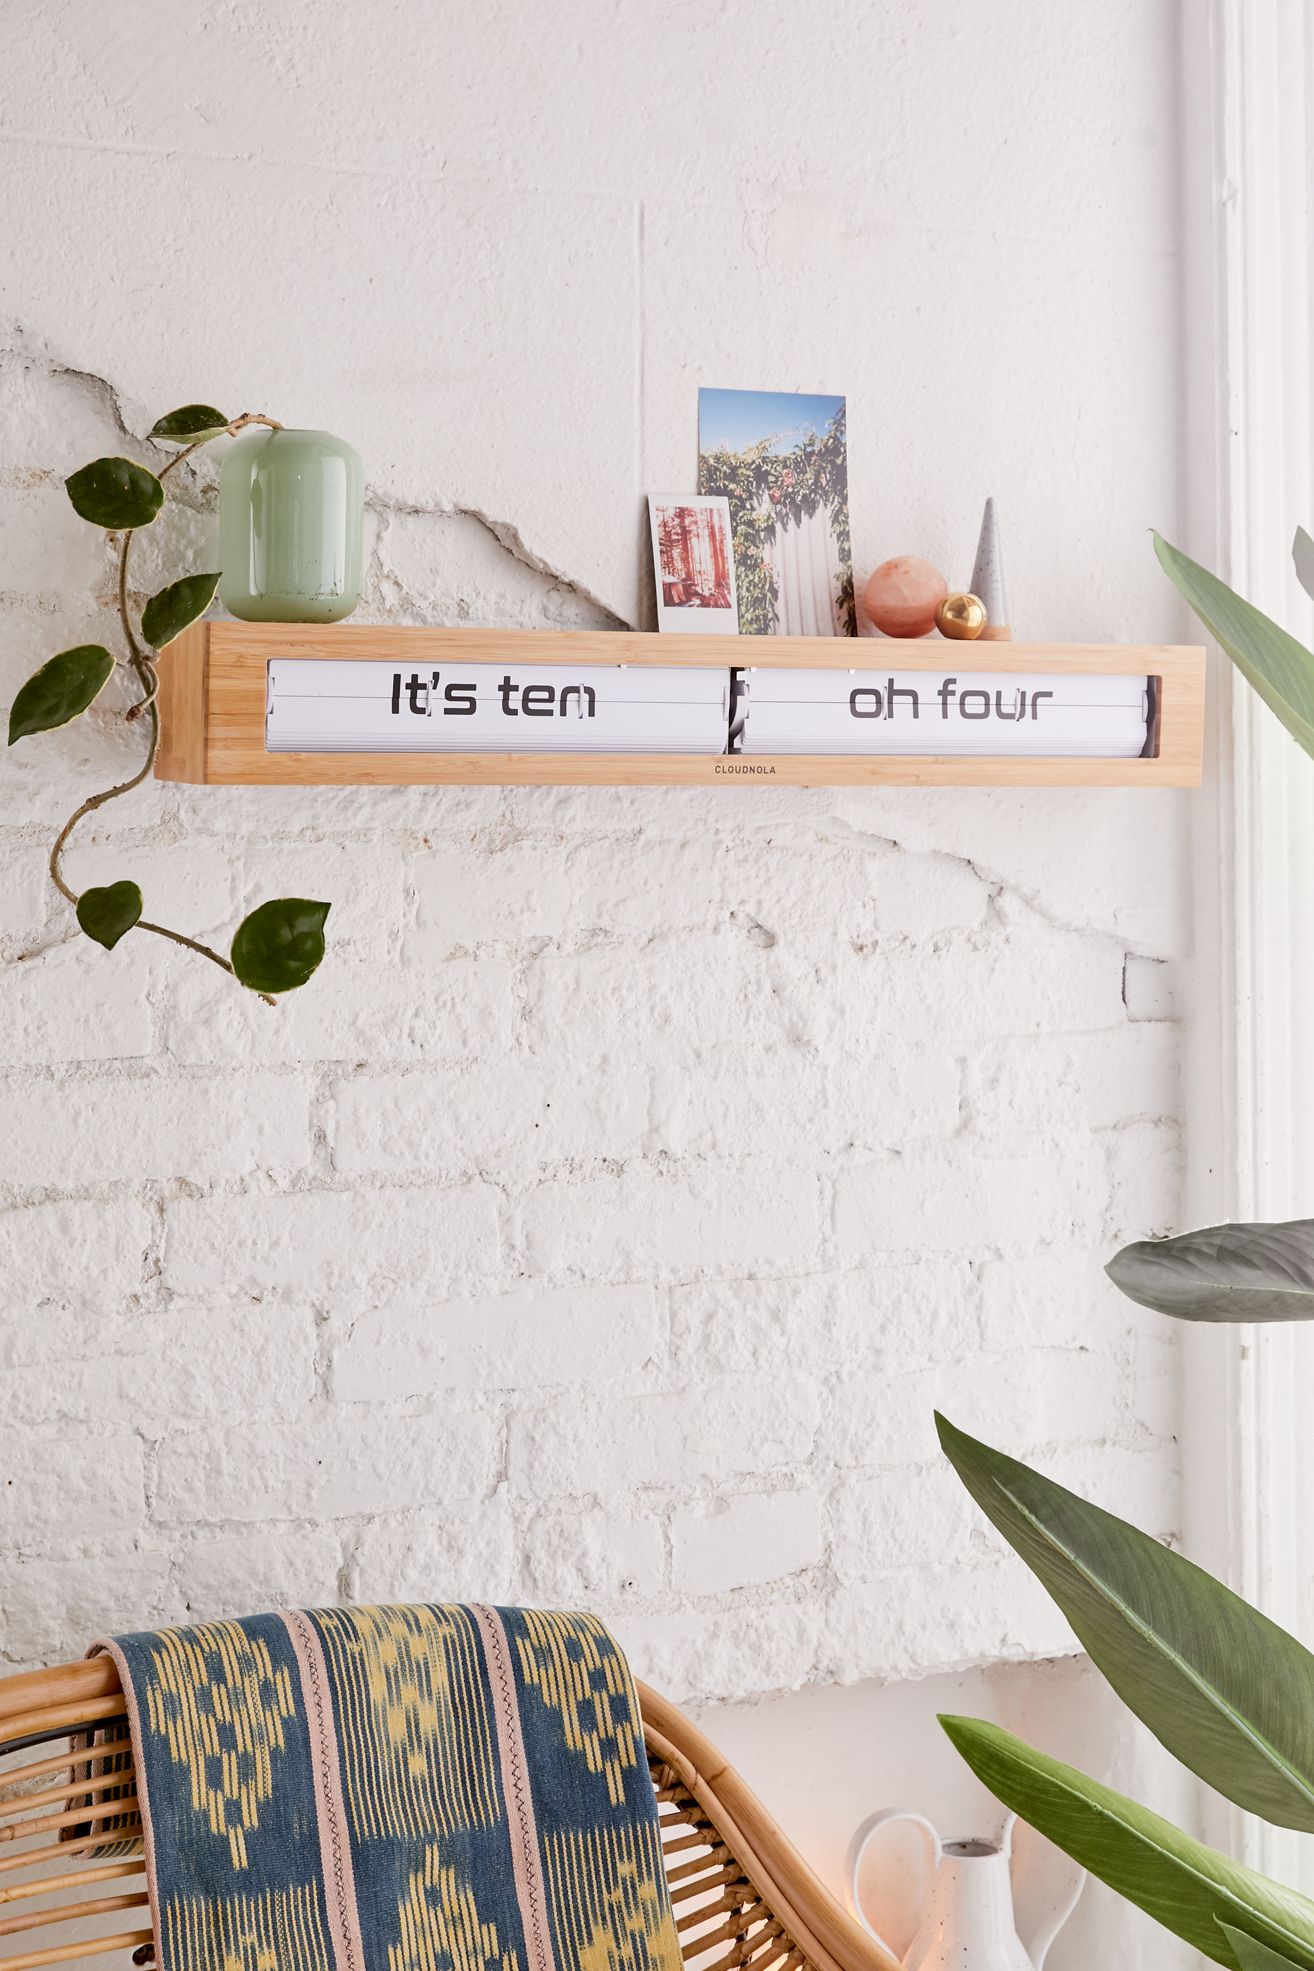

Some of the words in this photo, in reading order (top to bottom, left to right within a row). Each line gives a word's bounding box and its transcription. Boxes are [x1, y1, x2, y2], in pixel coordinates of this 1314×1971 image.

[391, 671, 477, 716] It's
[498, 675, 596, 717] ten
[849, 677, 919, 719] oh
[937, 677, 1053, 720] four
[714, 765, 776, 774] CLOUDNOLA
